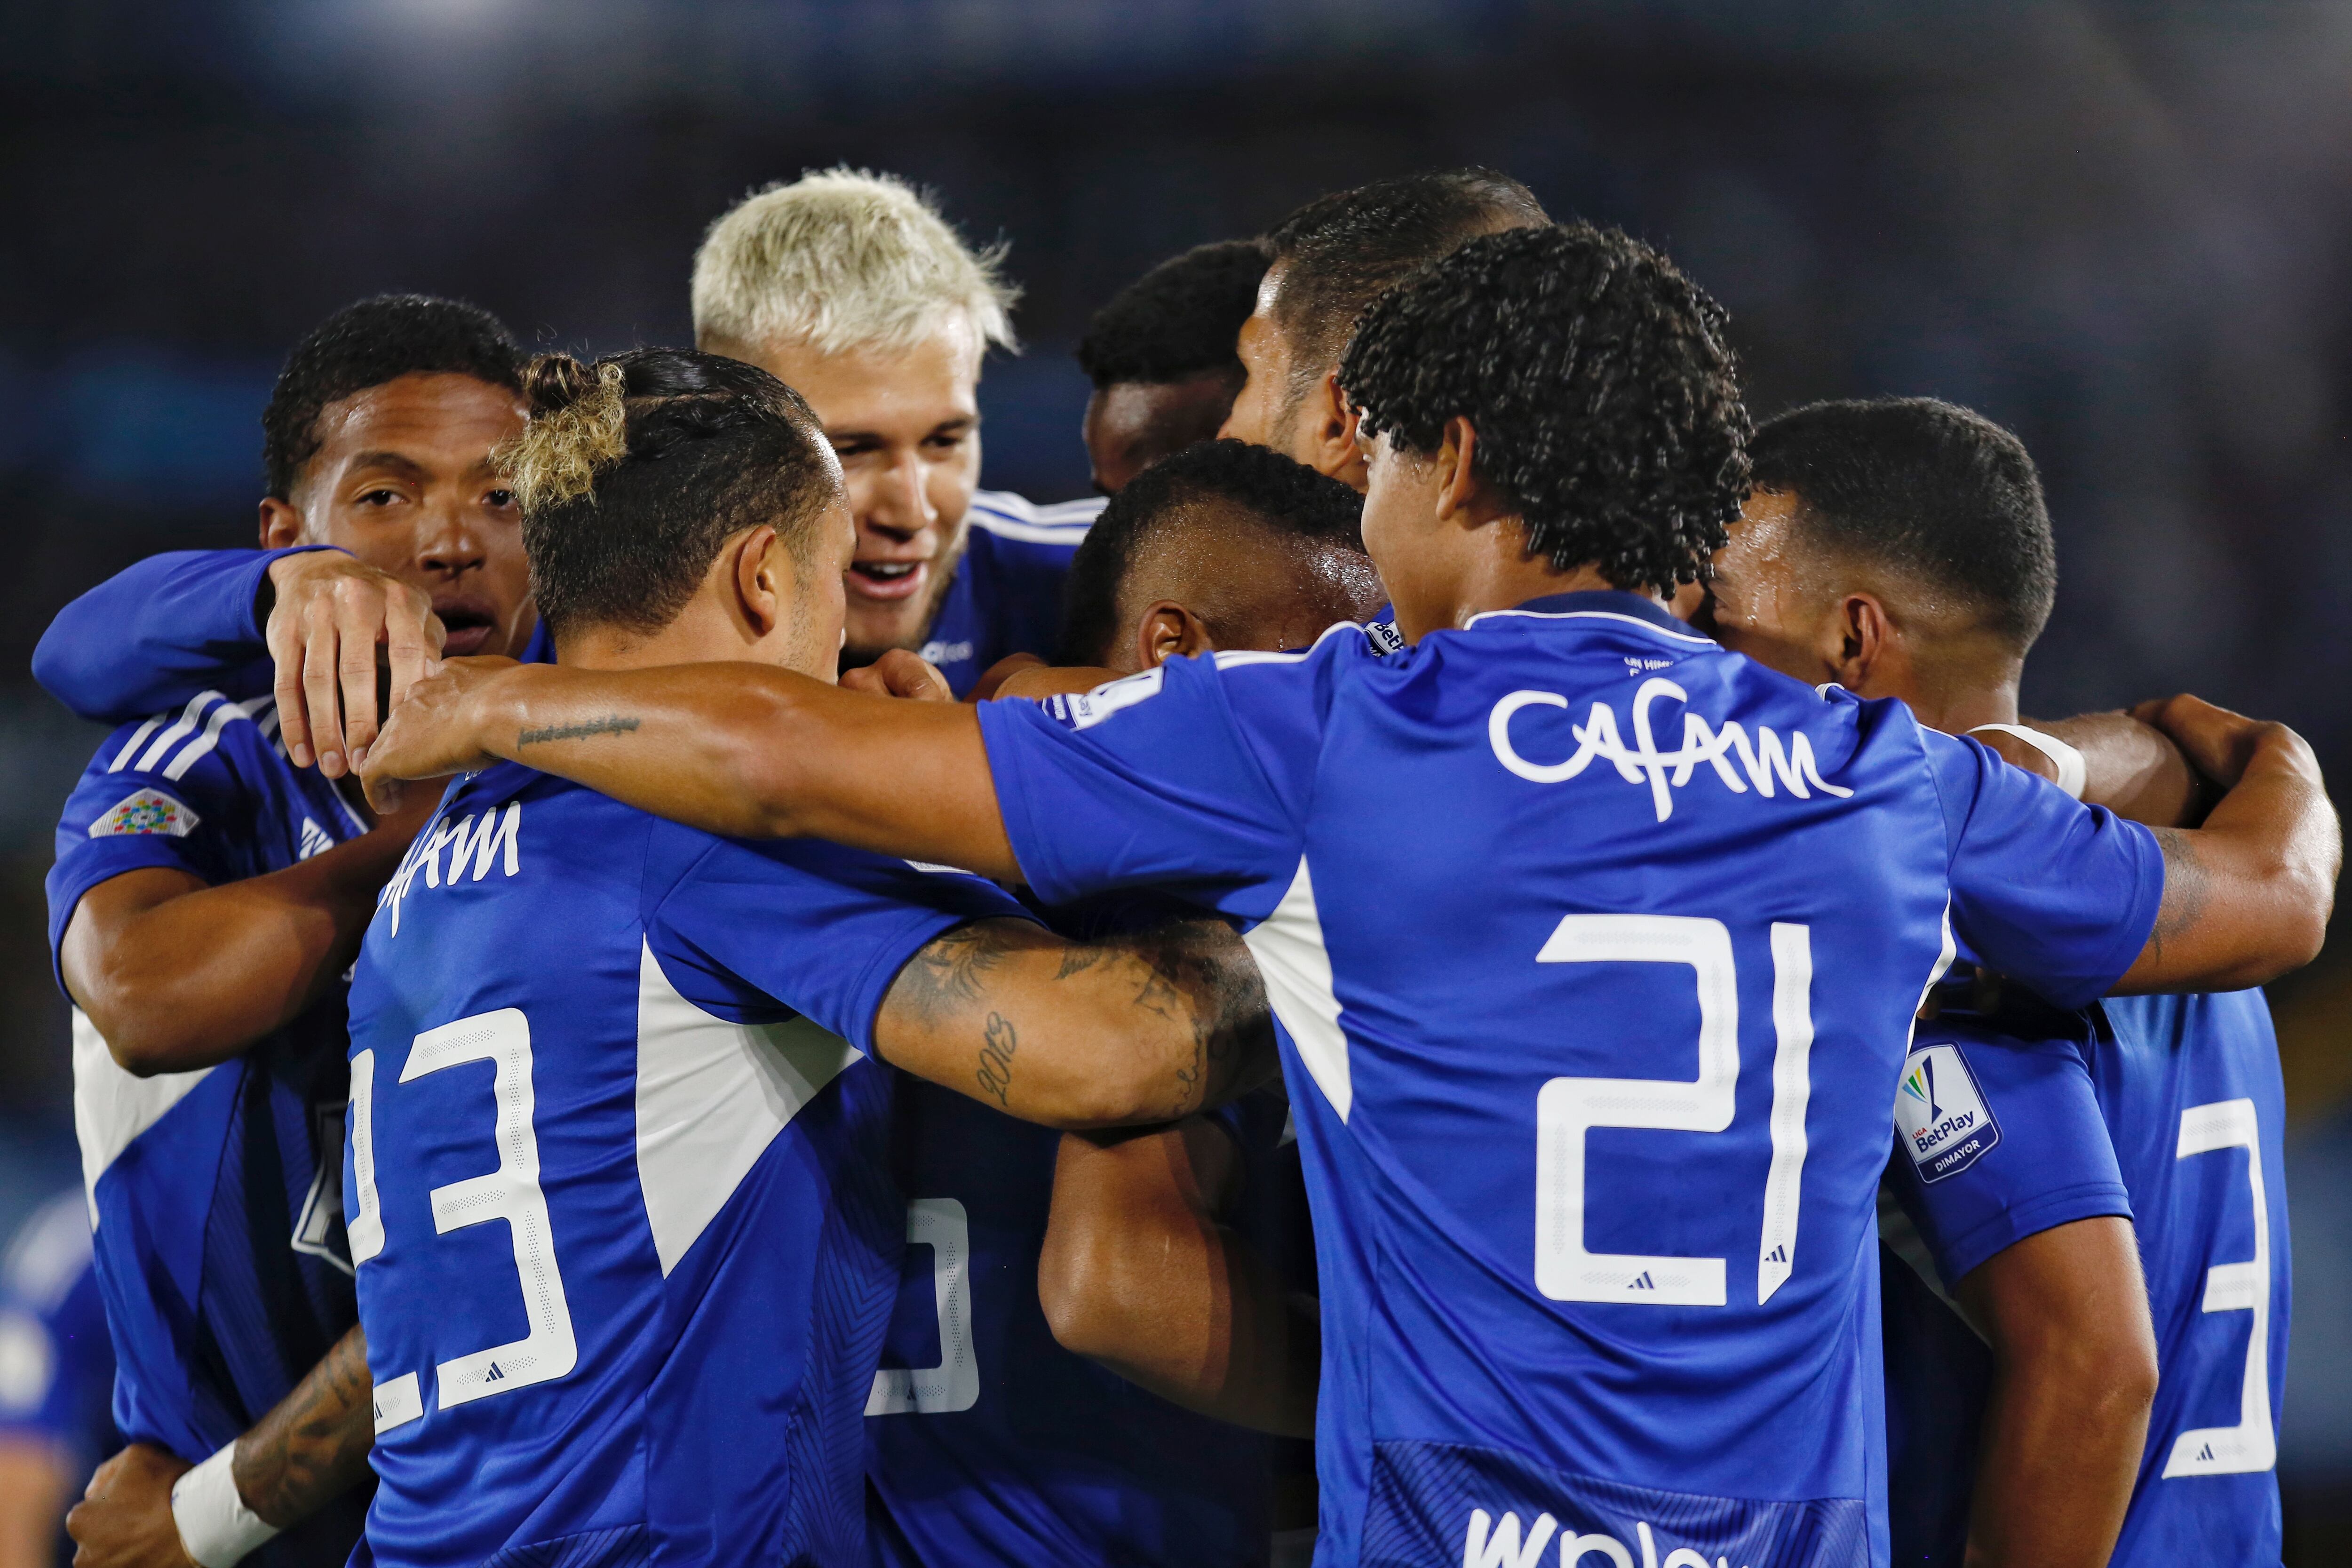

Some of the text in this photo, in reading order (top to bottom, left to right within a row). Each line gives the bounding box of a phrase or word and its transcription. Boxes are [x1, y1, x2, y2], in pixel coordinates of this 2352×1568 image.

[1535, 914, 1814, 1306] 21
[1912, 1127, 1927, 1139] LIGA
[1915, 1111, 1973, 1153] BetPlay
[1935, 1139, 1981, 1172] DIMAYOR
[2162, 1098, 2276, 1478] 3
